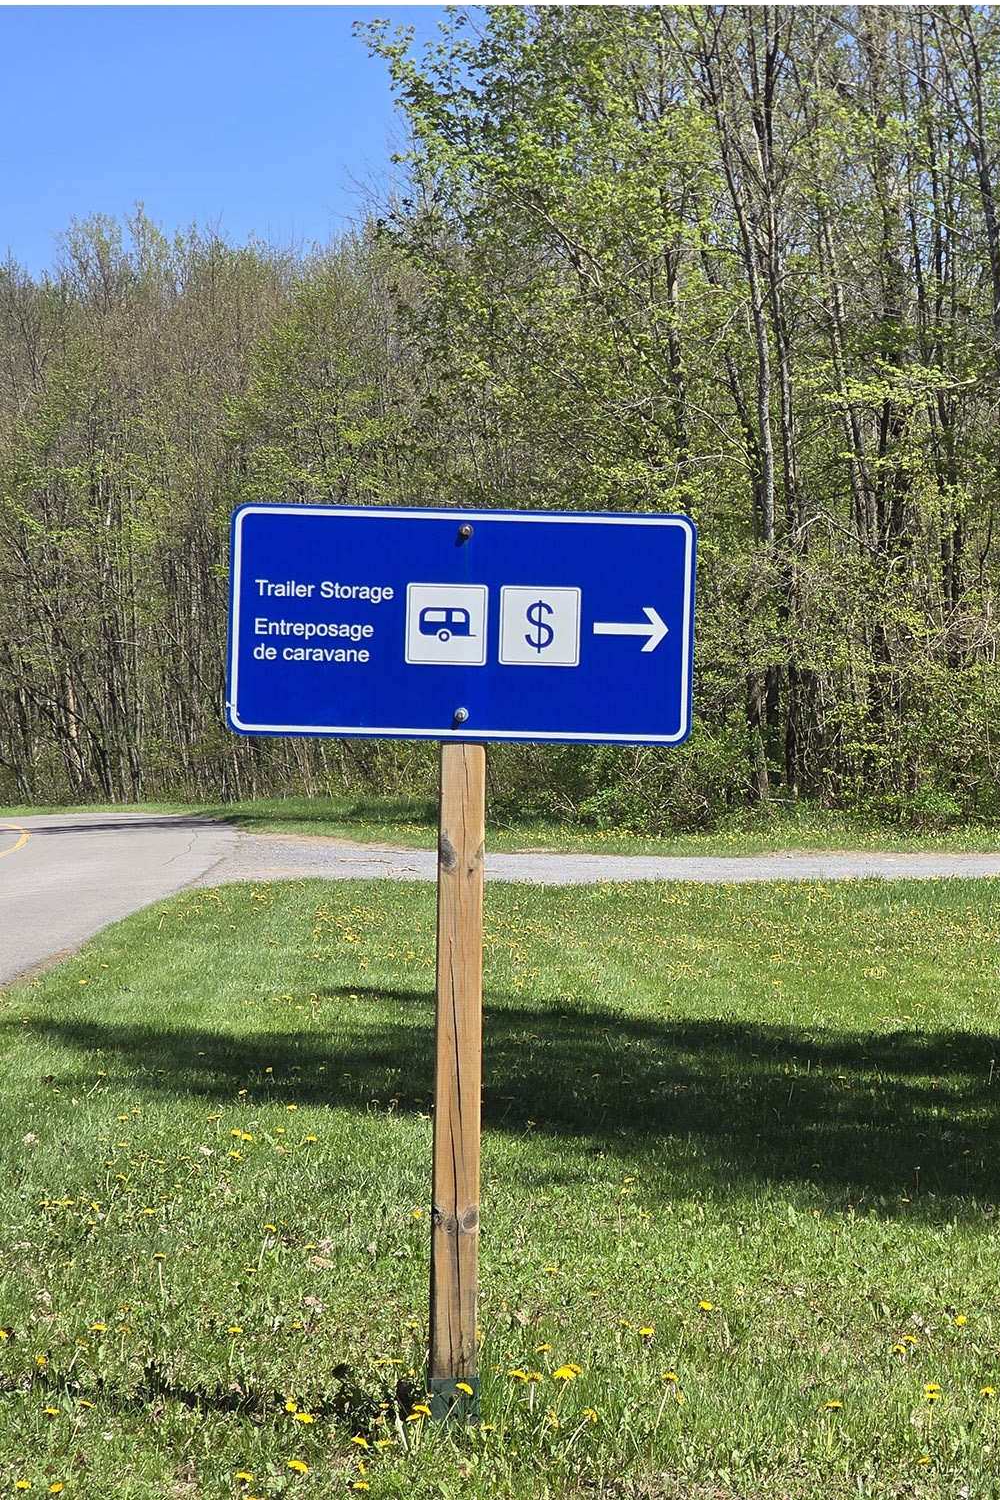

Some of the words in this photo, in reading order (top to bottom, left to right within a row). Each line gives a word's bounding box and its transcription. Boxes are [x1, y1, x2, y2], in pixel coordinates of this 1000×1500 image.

[254, 579, 316, 598] Trailer
[320, 581, 395, 604] Storage
[254, 617, 375, 641] Entreposage
[524, 599, 555, 654] $
[253, 642, 277, 660] de
[282, 647, 370, 663] caravane
